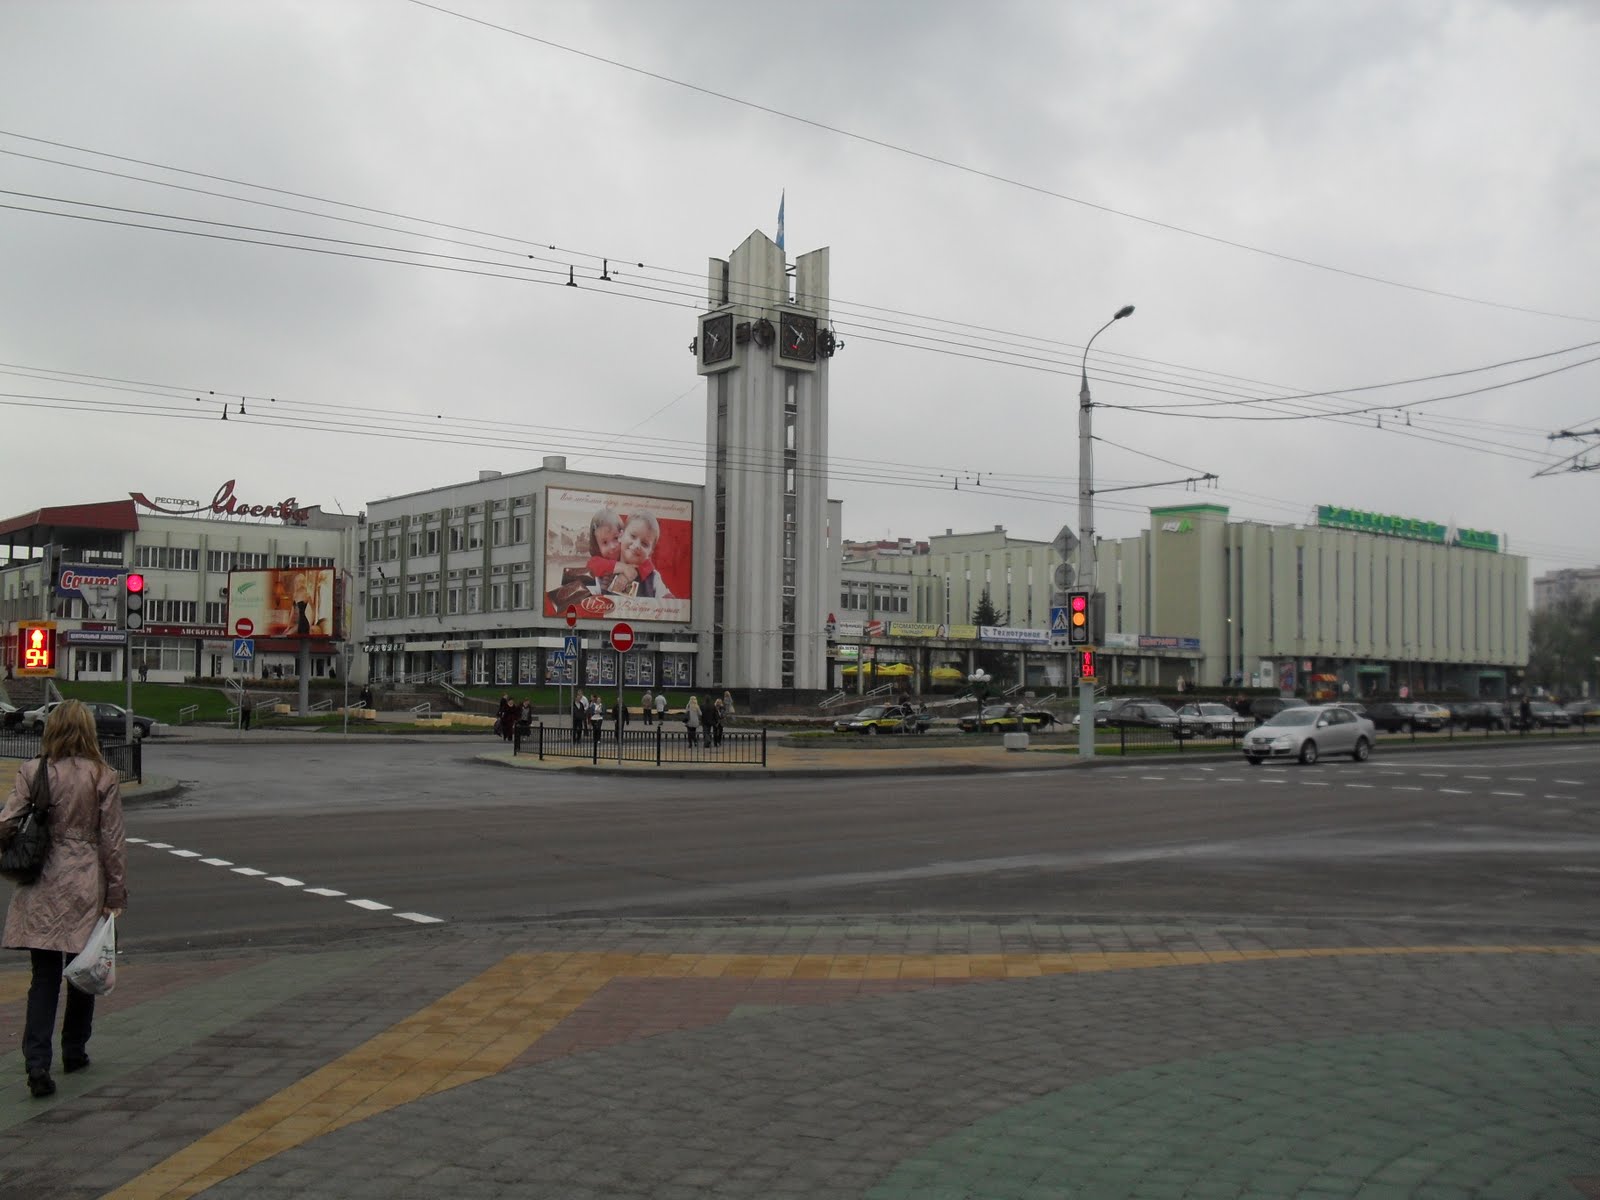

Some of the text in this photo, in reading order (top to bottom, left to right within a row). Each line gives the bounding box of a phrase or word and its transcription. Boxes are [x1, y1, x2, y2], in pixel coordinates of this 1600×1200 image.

[211, 479, 310, 521] Москва
[892, 622, 935, 630] СТОМАТОЛОГИЯ
[180, 628, 225, 636] ДИСКОТЕКА
